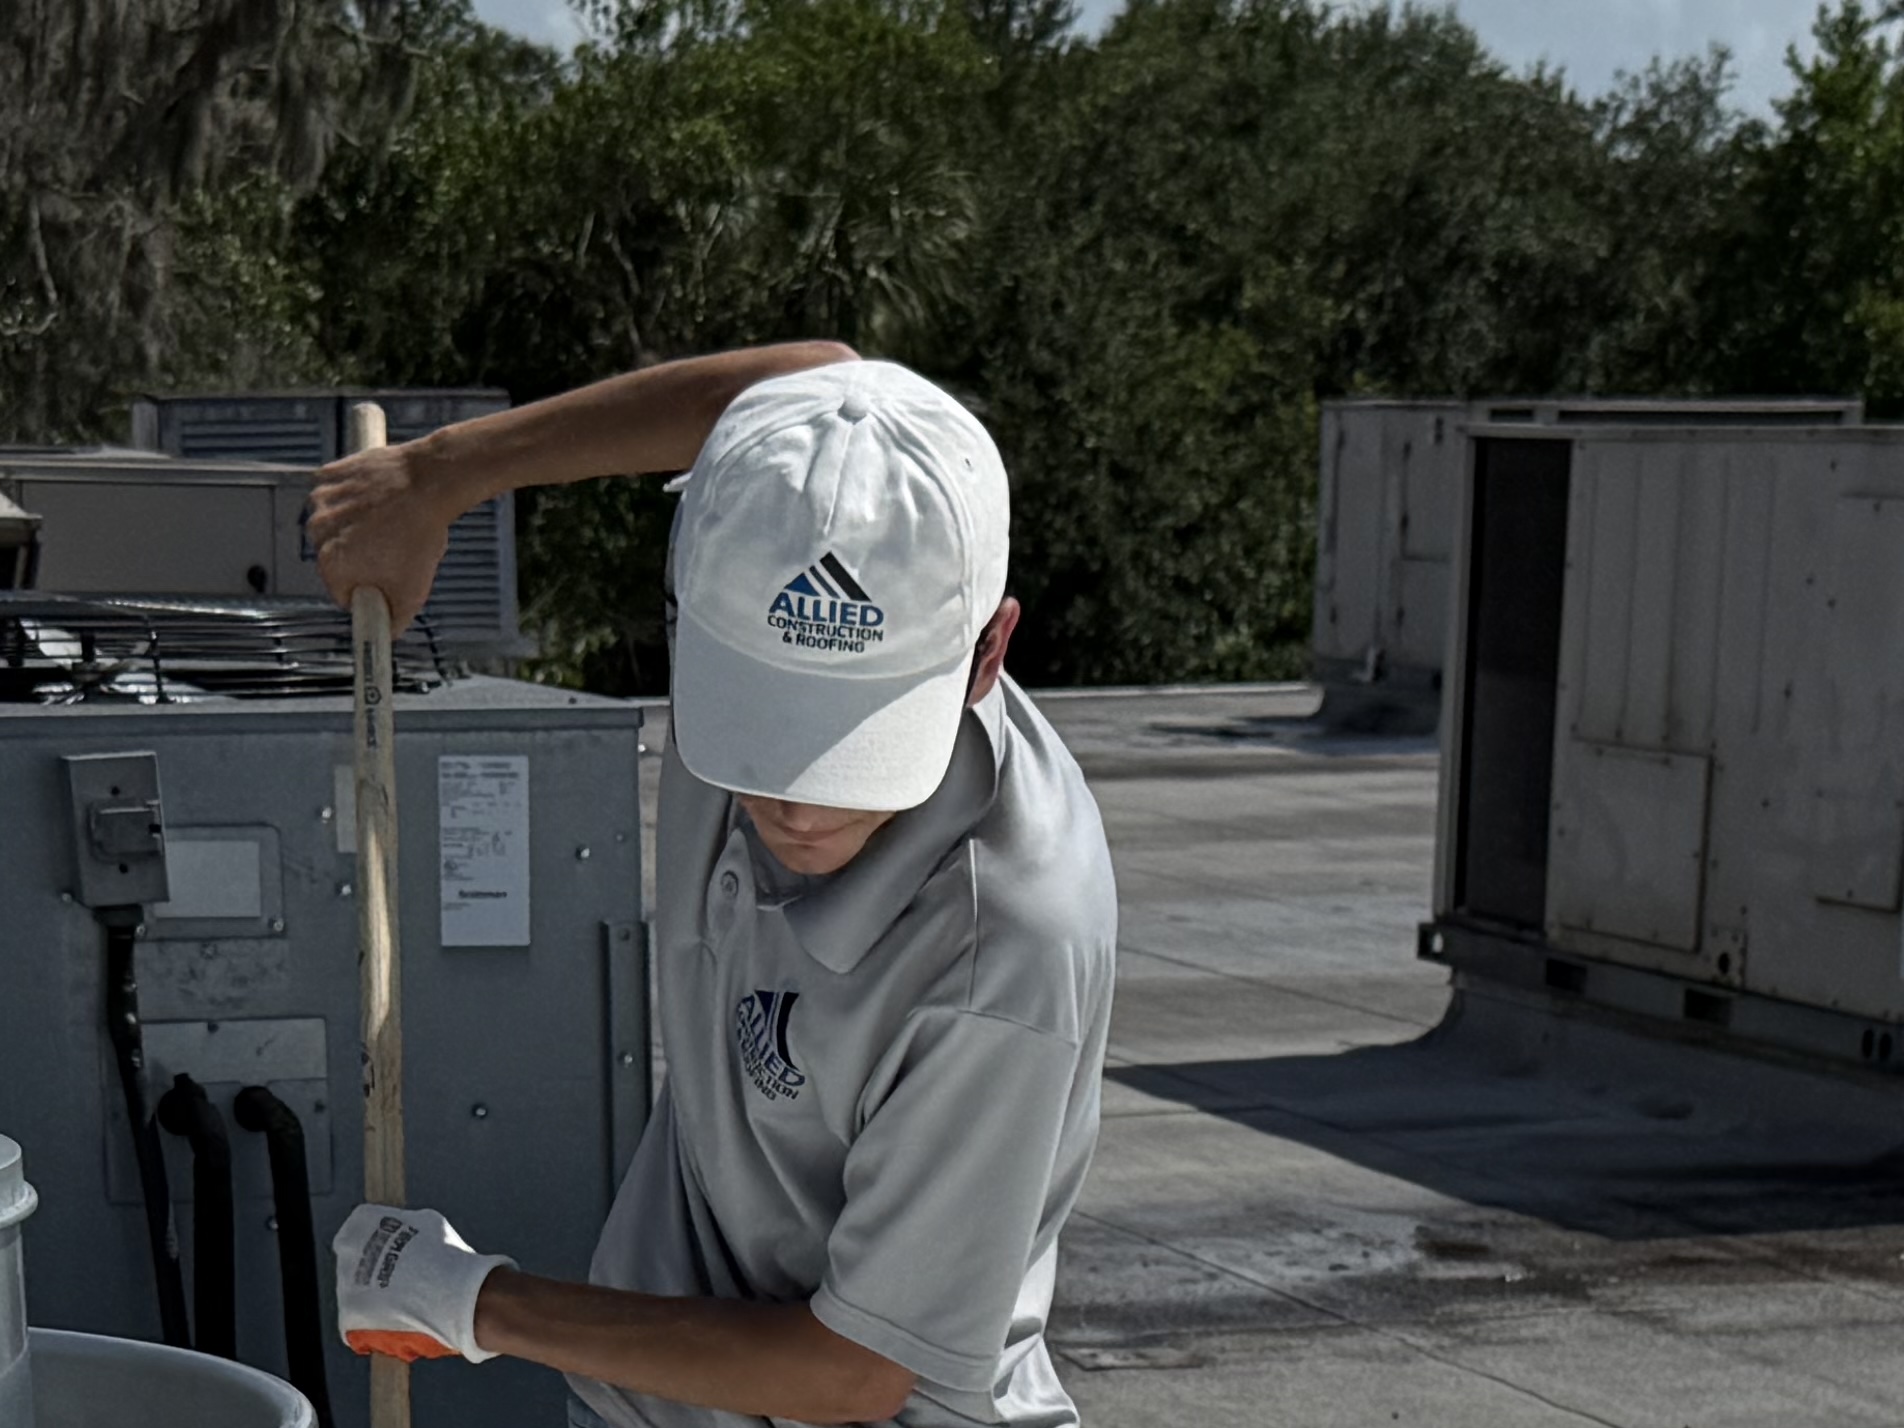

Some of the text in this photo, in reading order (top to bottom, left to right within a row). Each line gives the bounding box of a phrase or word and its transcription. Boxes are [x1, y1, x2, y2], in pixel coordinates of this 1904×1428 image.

[768, 592, 884, 627] ALLIED
[767, 614, 883, 641] CONSTRUCTION
[782, 631, 865, 653] & ROOFING
[736, 994, 806, 1086] ALLIED
